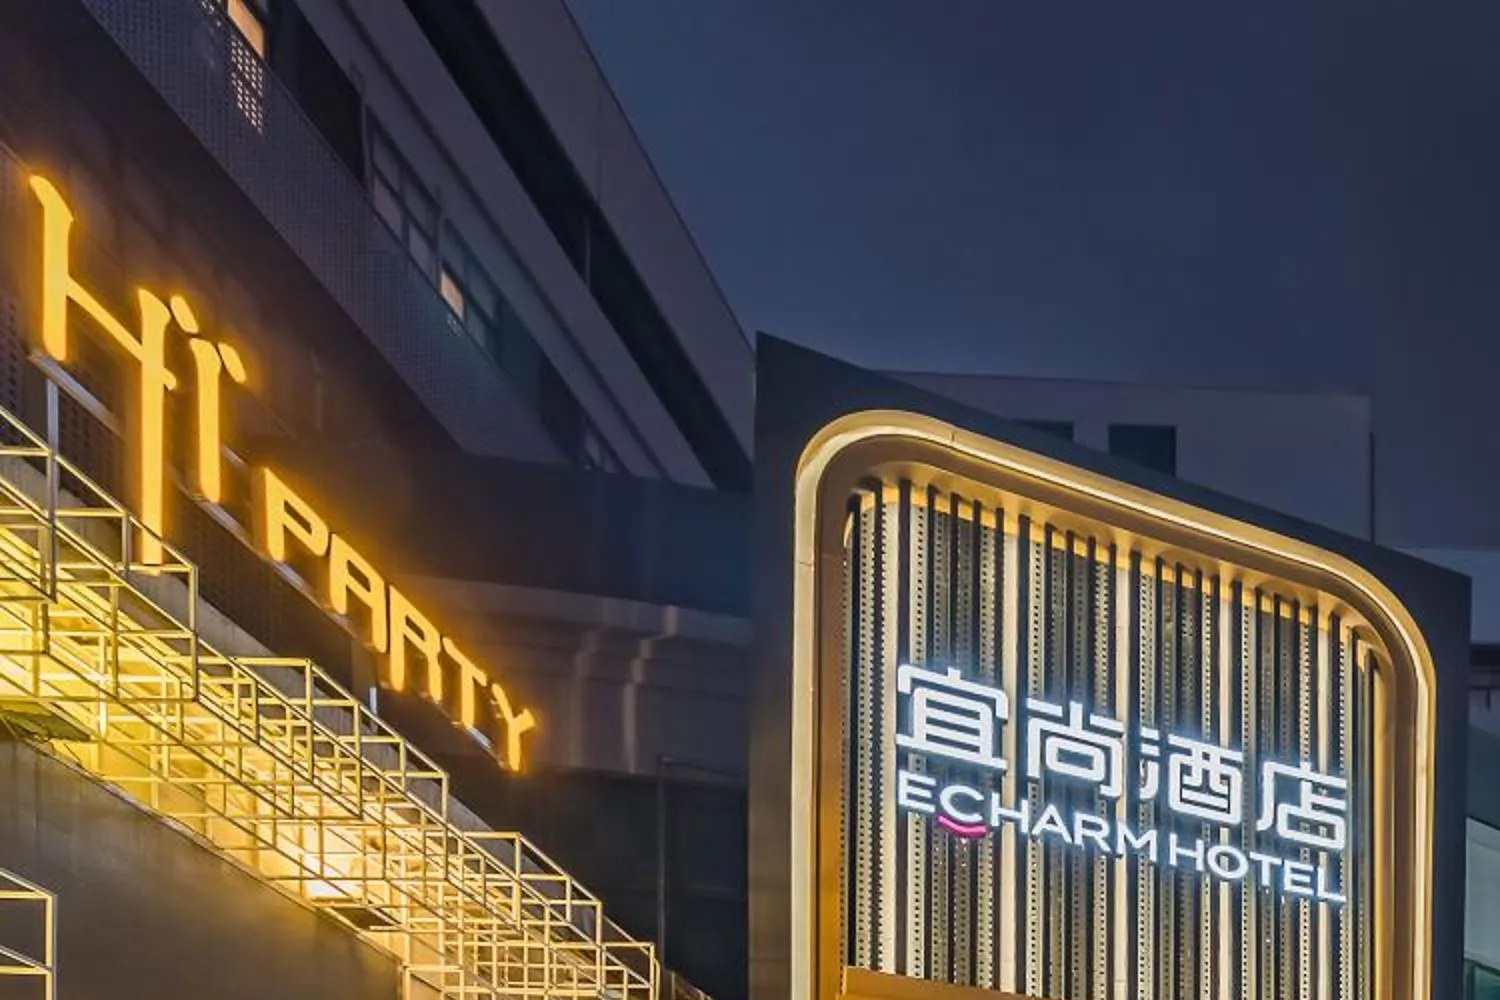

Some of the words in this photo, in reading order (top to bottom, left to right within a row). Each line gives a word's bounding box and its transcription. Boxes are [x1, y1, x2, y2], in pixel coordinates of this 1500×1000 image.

[262, 467, 537, 773] PARTY
[895, 663, 1348, 851] 宜尚酒店
[898, 769, 1158, 863] ECHARM
[1168, 833, 1348, 903] HOTEL
